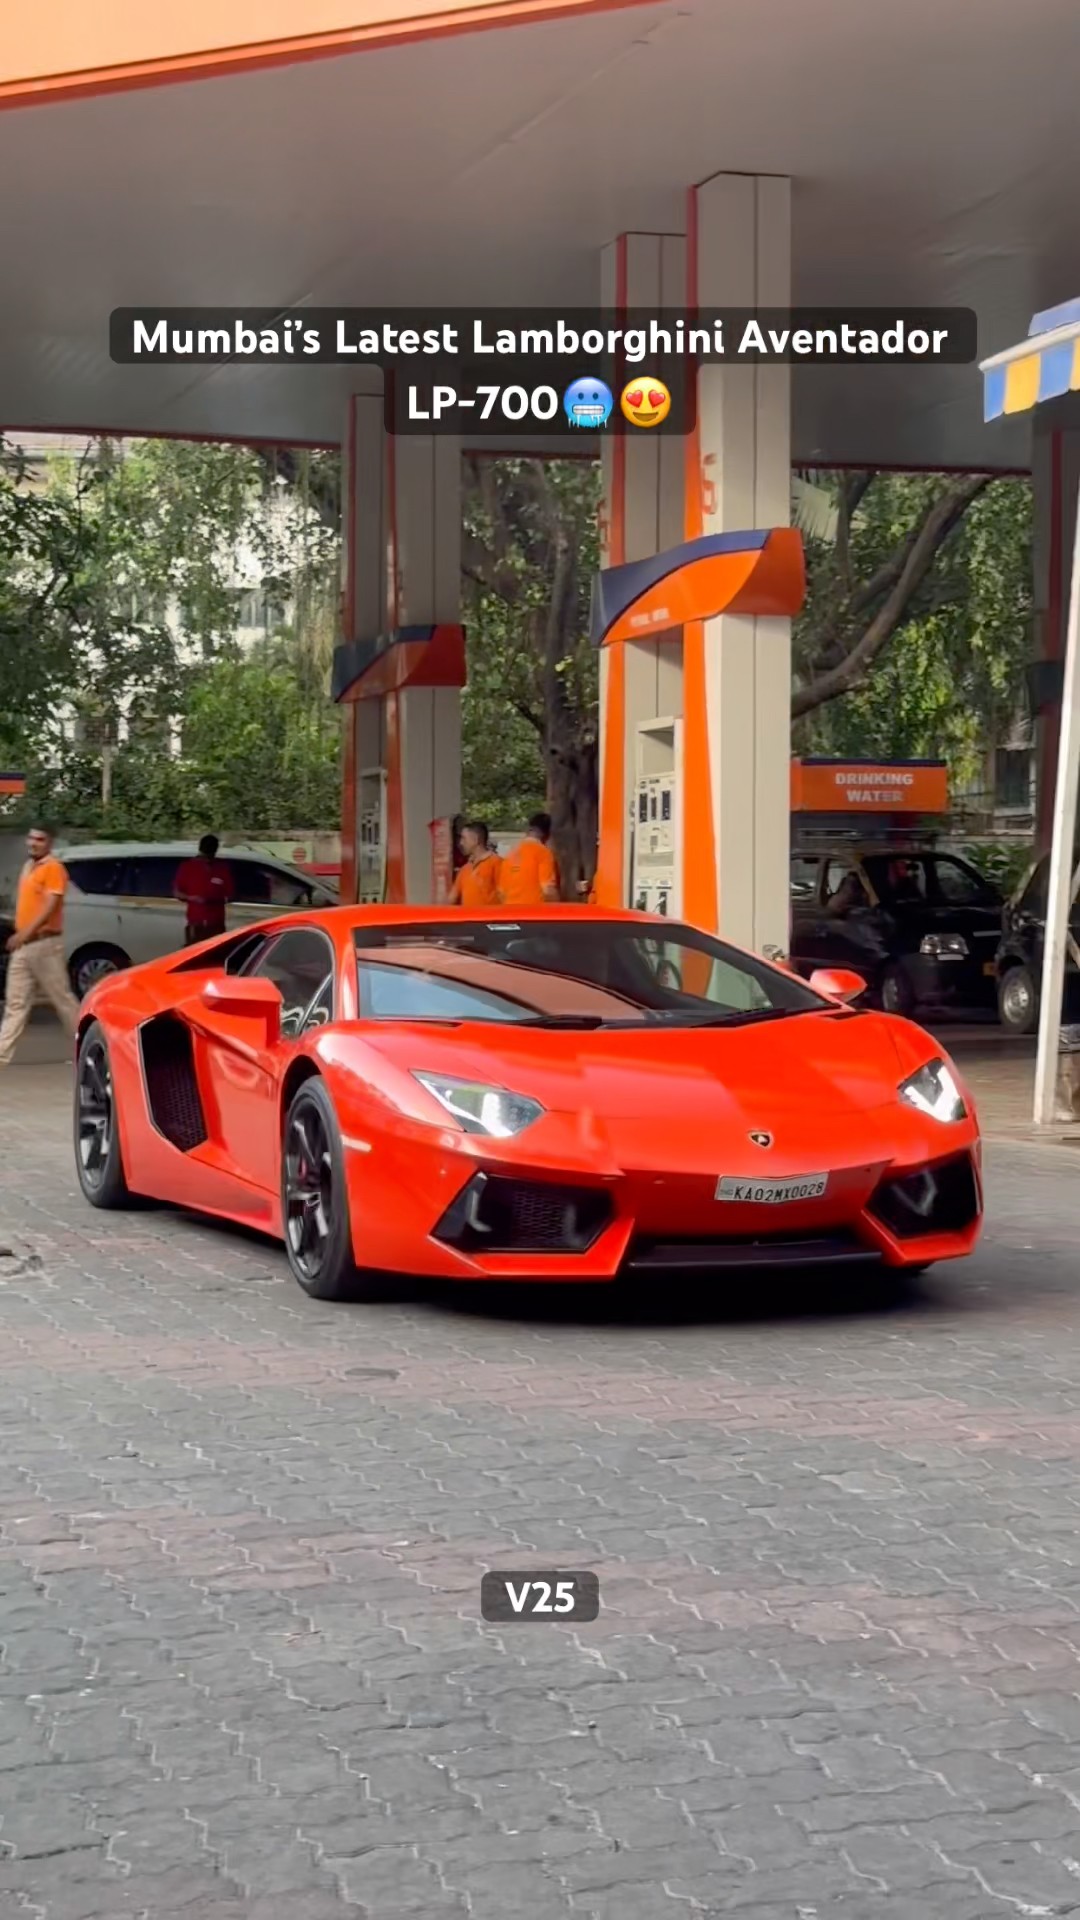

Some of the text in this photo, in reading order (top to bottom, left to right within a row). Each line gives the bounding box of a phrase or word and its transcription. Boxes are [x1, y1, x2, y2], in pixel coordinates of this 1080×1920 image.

[835, 773, 914, 785] DRINKING
[846, 790, 904, 802] WATER
[733, 1181, 825, 1202] KA02MX0028
